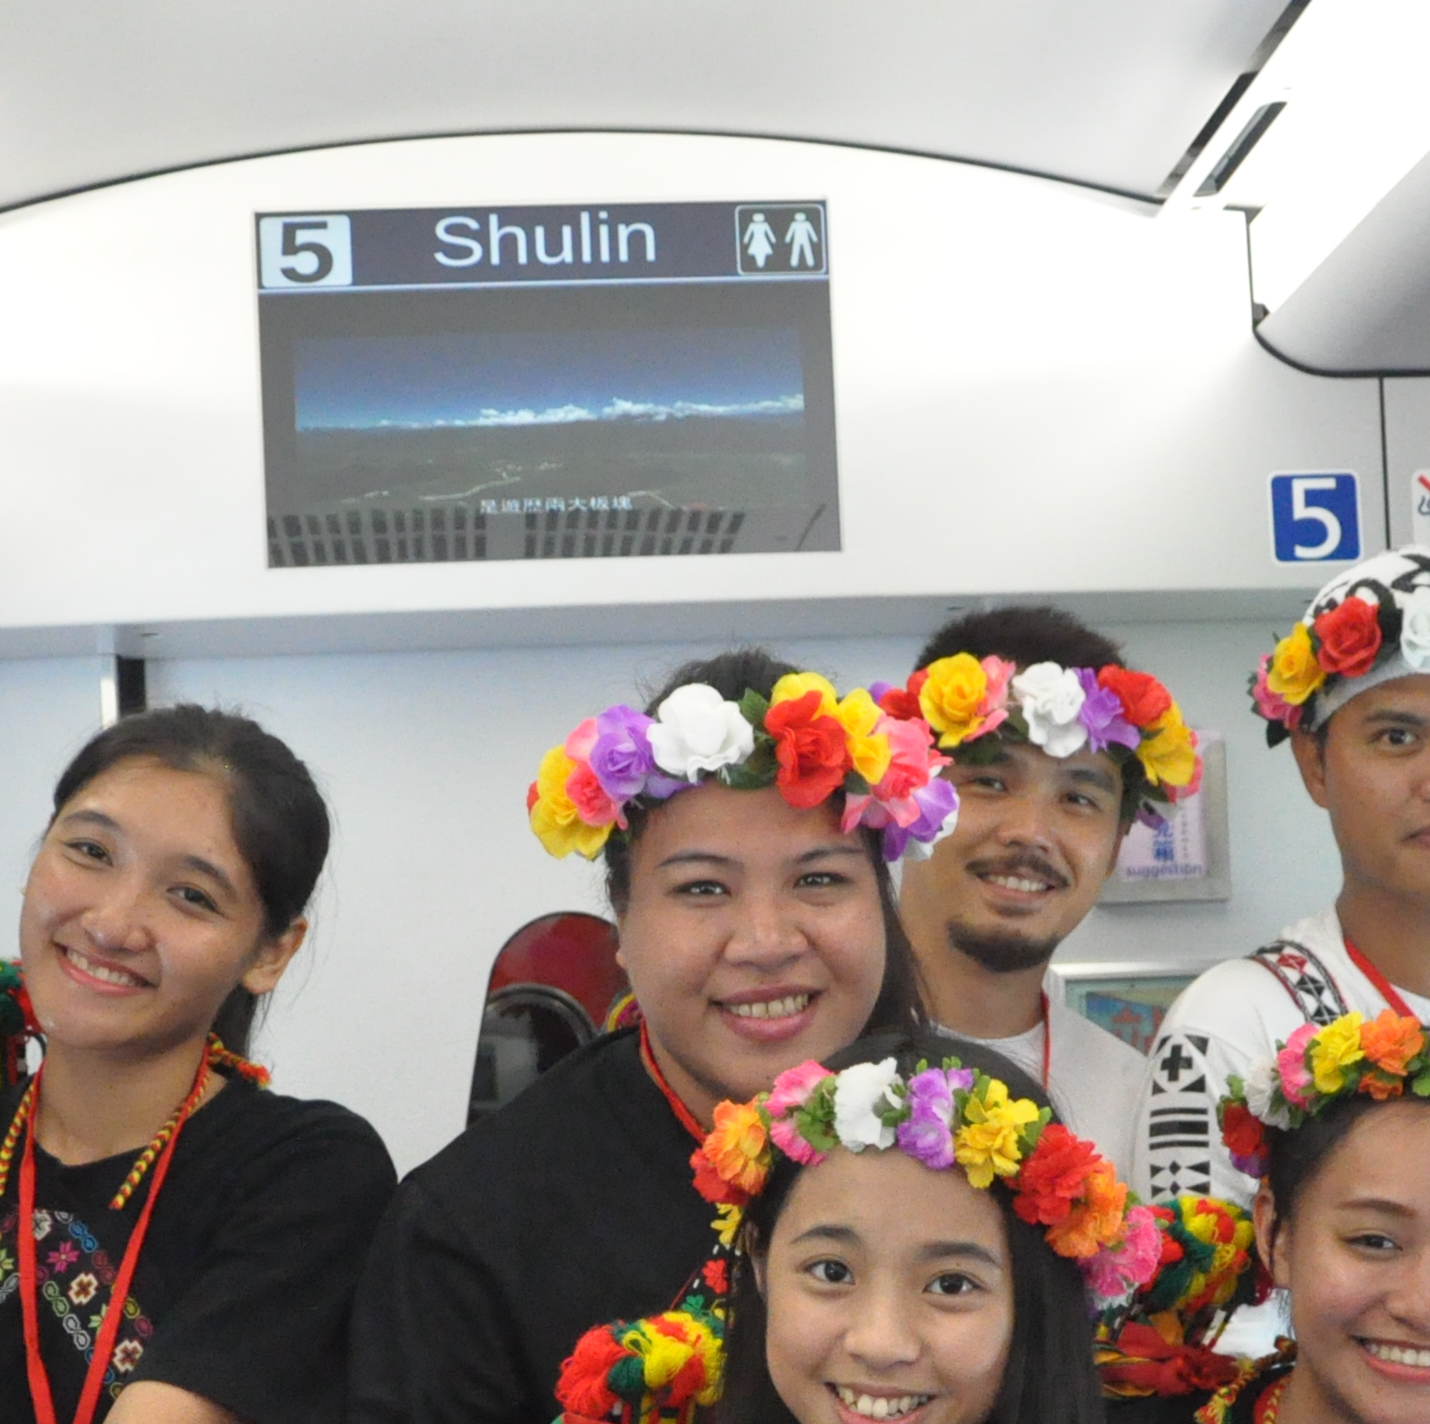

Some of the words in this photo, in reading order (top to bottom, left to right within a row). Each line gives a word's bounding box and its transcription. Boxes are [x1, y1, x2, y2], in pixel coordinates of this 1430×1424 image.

[279, 220, 334, 283] 5
[433, 211, 657, 268] Shulin
[1291, 477, 1343, 560] 5
